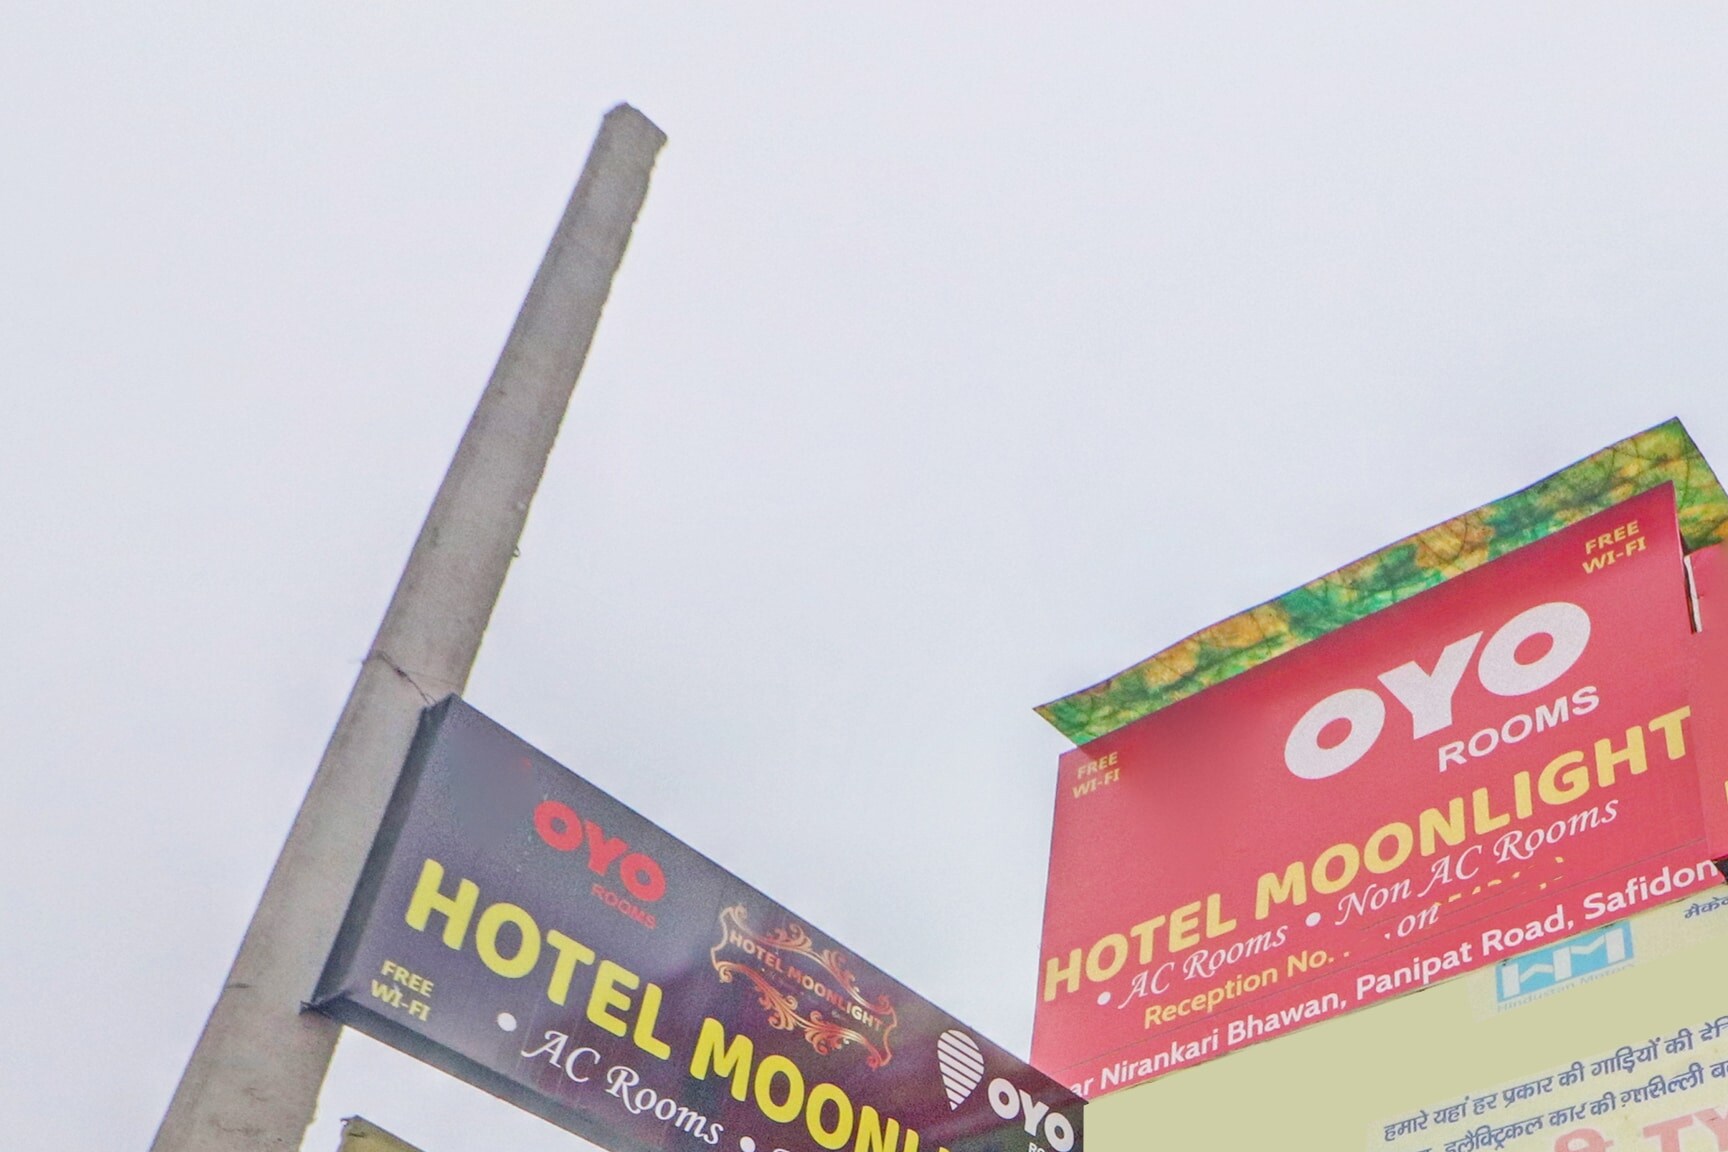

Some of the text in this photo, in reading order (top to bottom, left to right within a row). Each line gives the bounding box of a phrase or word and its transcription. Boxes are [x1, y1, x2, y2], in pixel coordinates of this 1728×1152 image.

[1581, 536, 1647, 575] WI-FI
[1585, 520, 1640, 555] FREE
[1283, 601, 1592, 780] OYO
[1437, 685, 1600, 773] ROOMS
[1072, 767, 1121, 799] WI-FI
[1076, 751, 1119, 781] FREE
[533, 800, 667, 903] OYO
[1043, 705, 1691, 1003] HOTEL MOONLIGHT
[591, 884, 657, 930] ROOMS
[1118, 798, 1619, 1010] AC Rooms Non AC Rooms
[370, 979, 432, 1022] WI-FI
[381, 960, 435, 998] FREE
[405, 858, 672, 1061] HOTEL
[729, 929, 885, 1032] HOTEL MOONLIGHT
[1100, 1028, 1220, 1091] Nirankari
[1226, 993, 1348, 1046] Bhawan,
[1356, 948, 1474, 1001] Panipat
[1482, 904, 1575, 957] Road,
[1583, 858, 1718, 921] Safidon
[1143, 946, 1335, 1030] Reception No.
[521, 1030, 601, 1083] AC
[605, 1065, 725, 1145] Rooms
[1384, 1109, 1430, 1142] हमारे
[1472, 1093, 1499, 1116] हर
[1502, 1075, 1554, 1109] प्रकार
[1557, 1061, 1586, 1088] की
[1664, 1027, 1694, 1054] की
